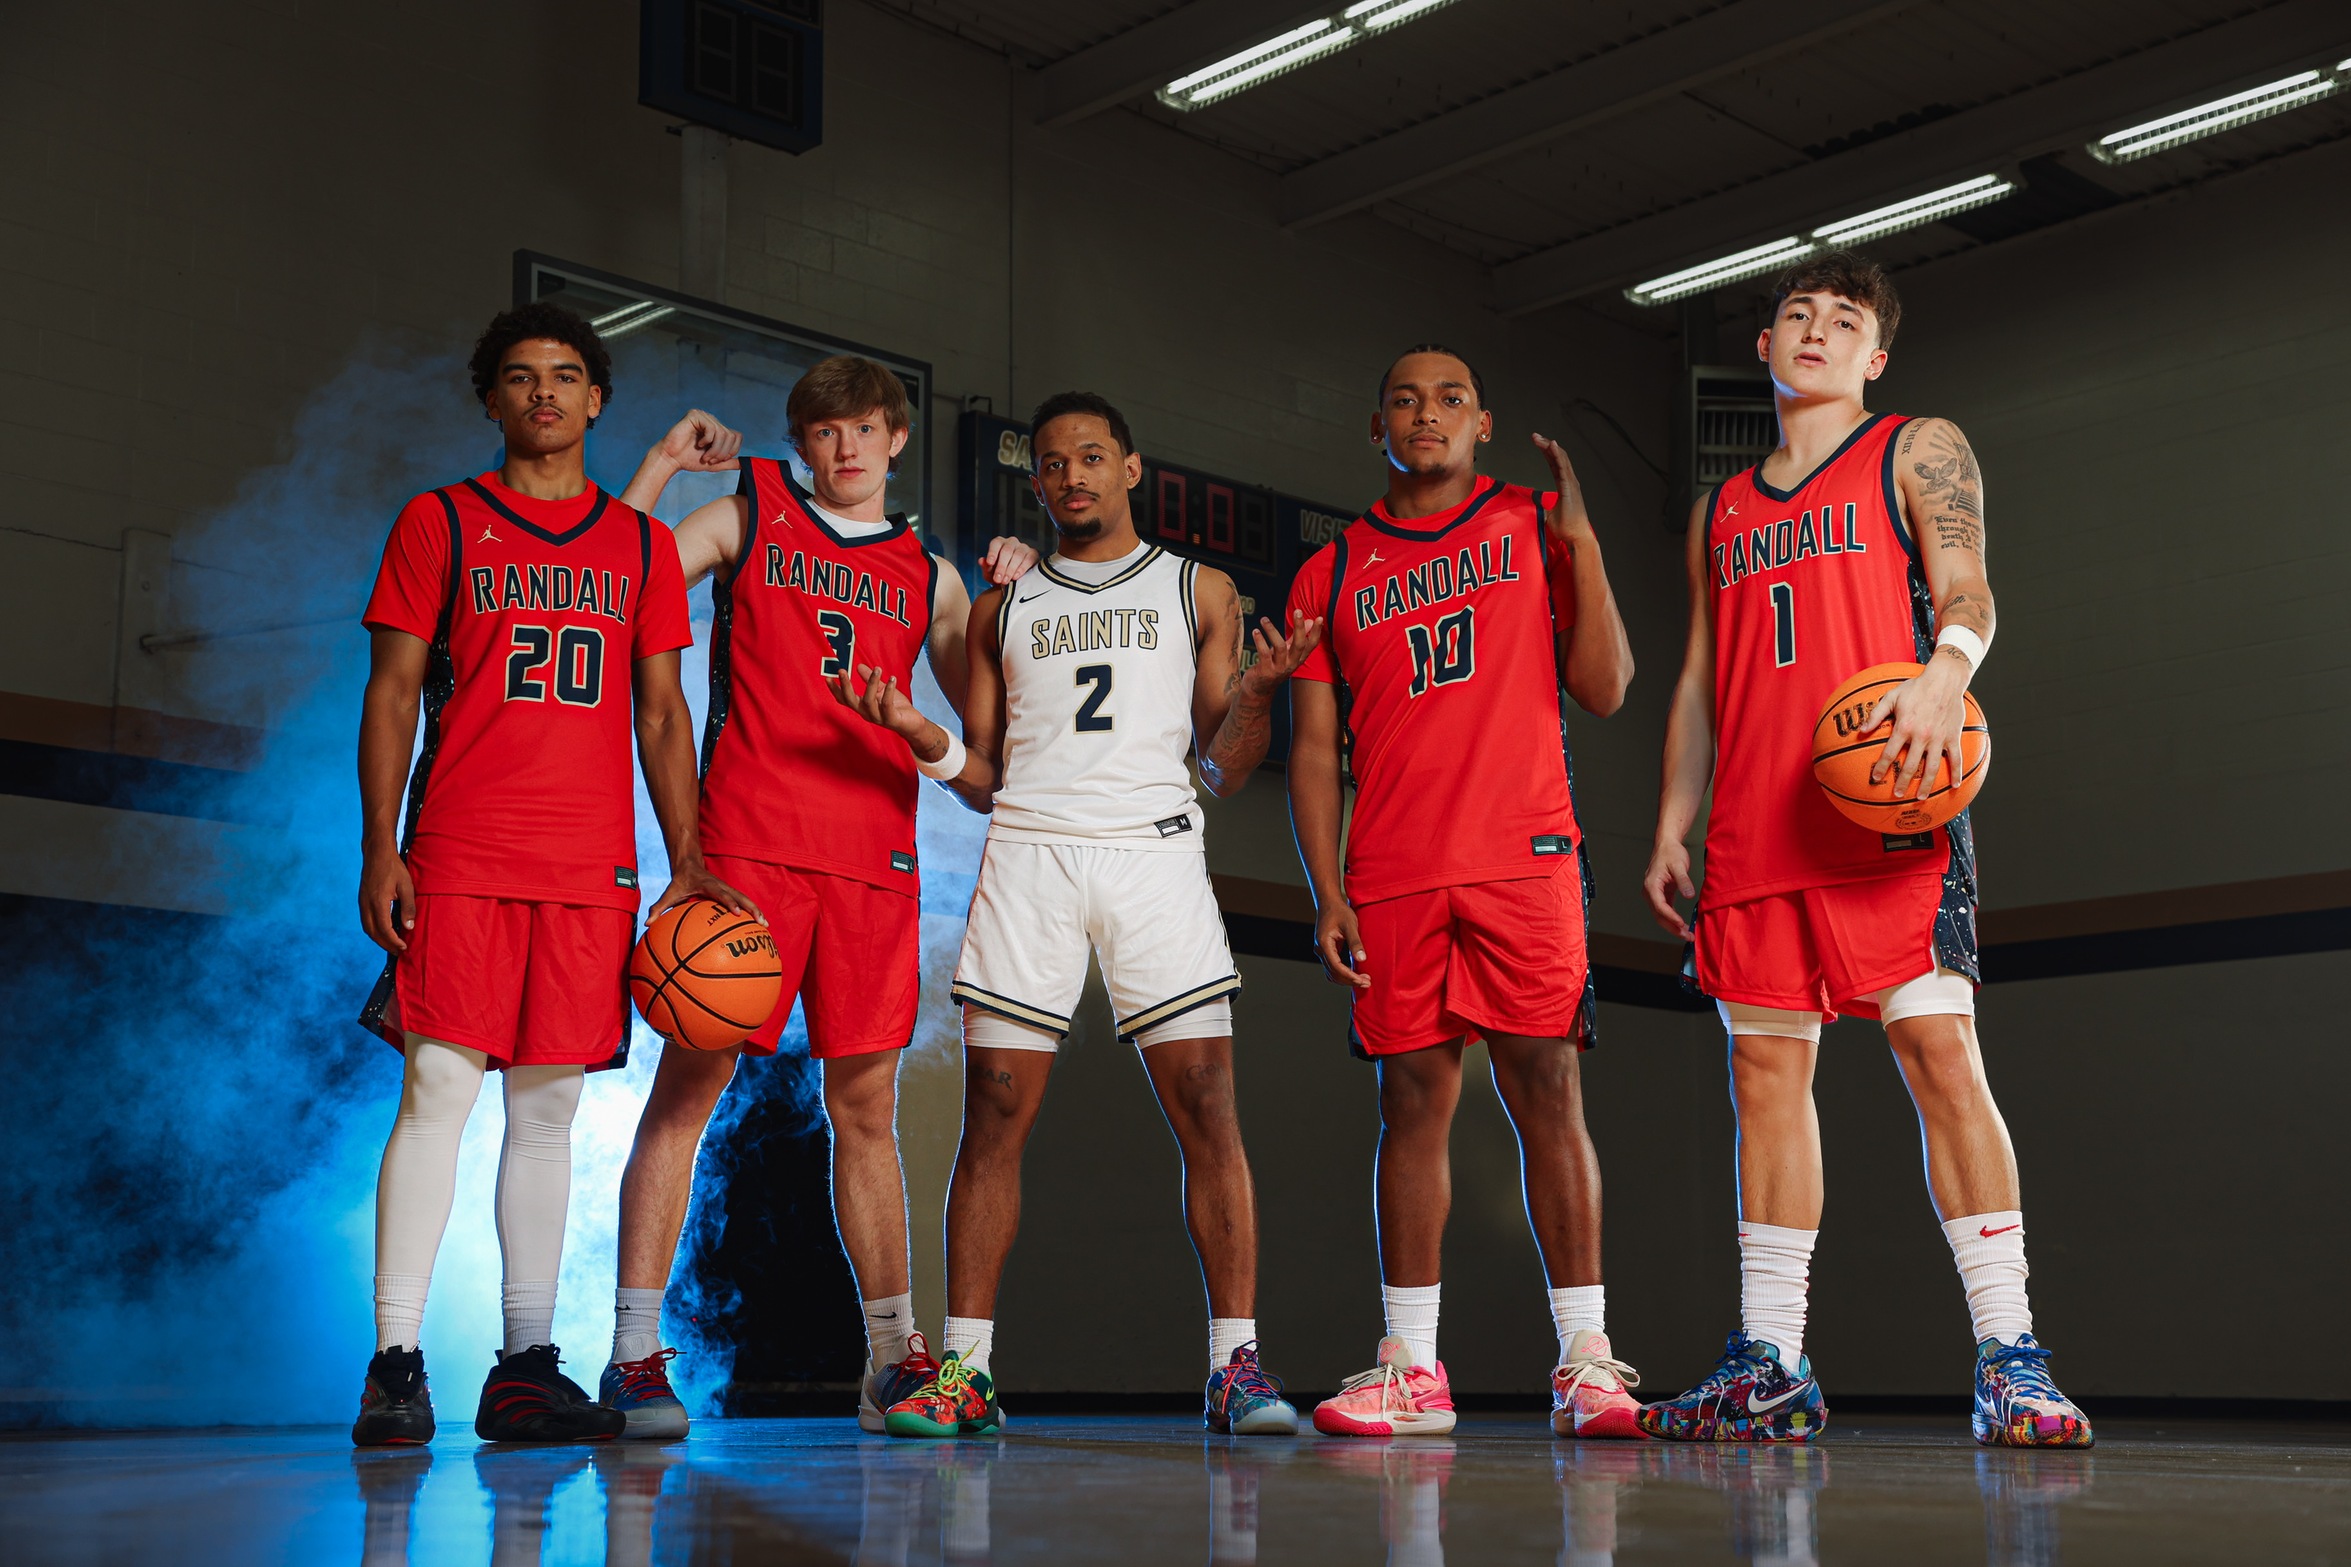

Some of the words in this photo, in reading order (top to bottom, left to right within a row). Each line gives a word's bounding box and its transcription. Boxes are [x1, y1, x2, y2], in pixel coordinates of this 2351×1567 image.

[765, 543, 911, 629] RANDALL
[1355, 534, 1519, 632] RANDALL
[1714, 502, 1866, 589] RANDALL
[470, 564, 629, 625] RANDALL
[1031, 609, 1159, 660] SAINTS
[1769, 581, 1796, 668] 1
[504, 624, 605, 708] 20
[817, 609, 855, 680] 3
[1404, 604, 1475, 699] 10
[1073, 662, 1115, 735] 2
[726, 934, 780, 959] ilson
